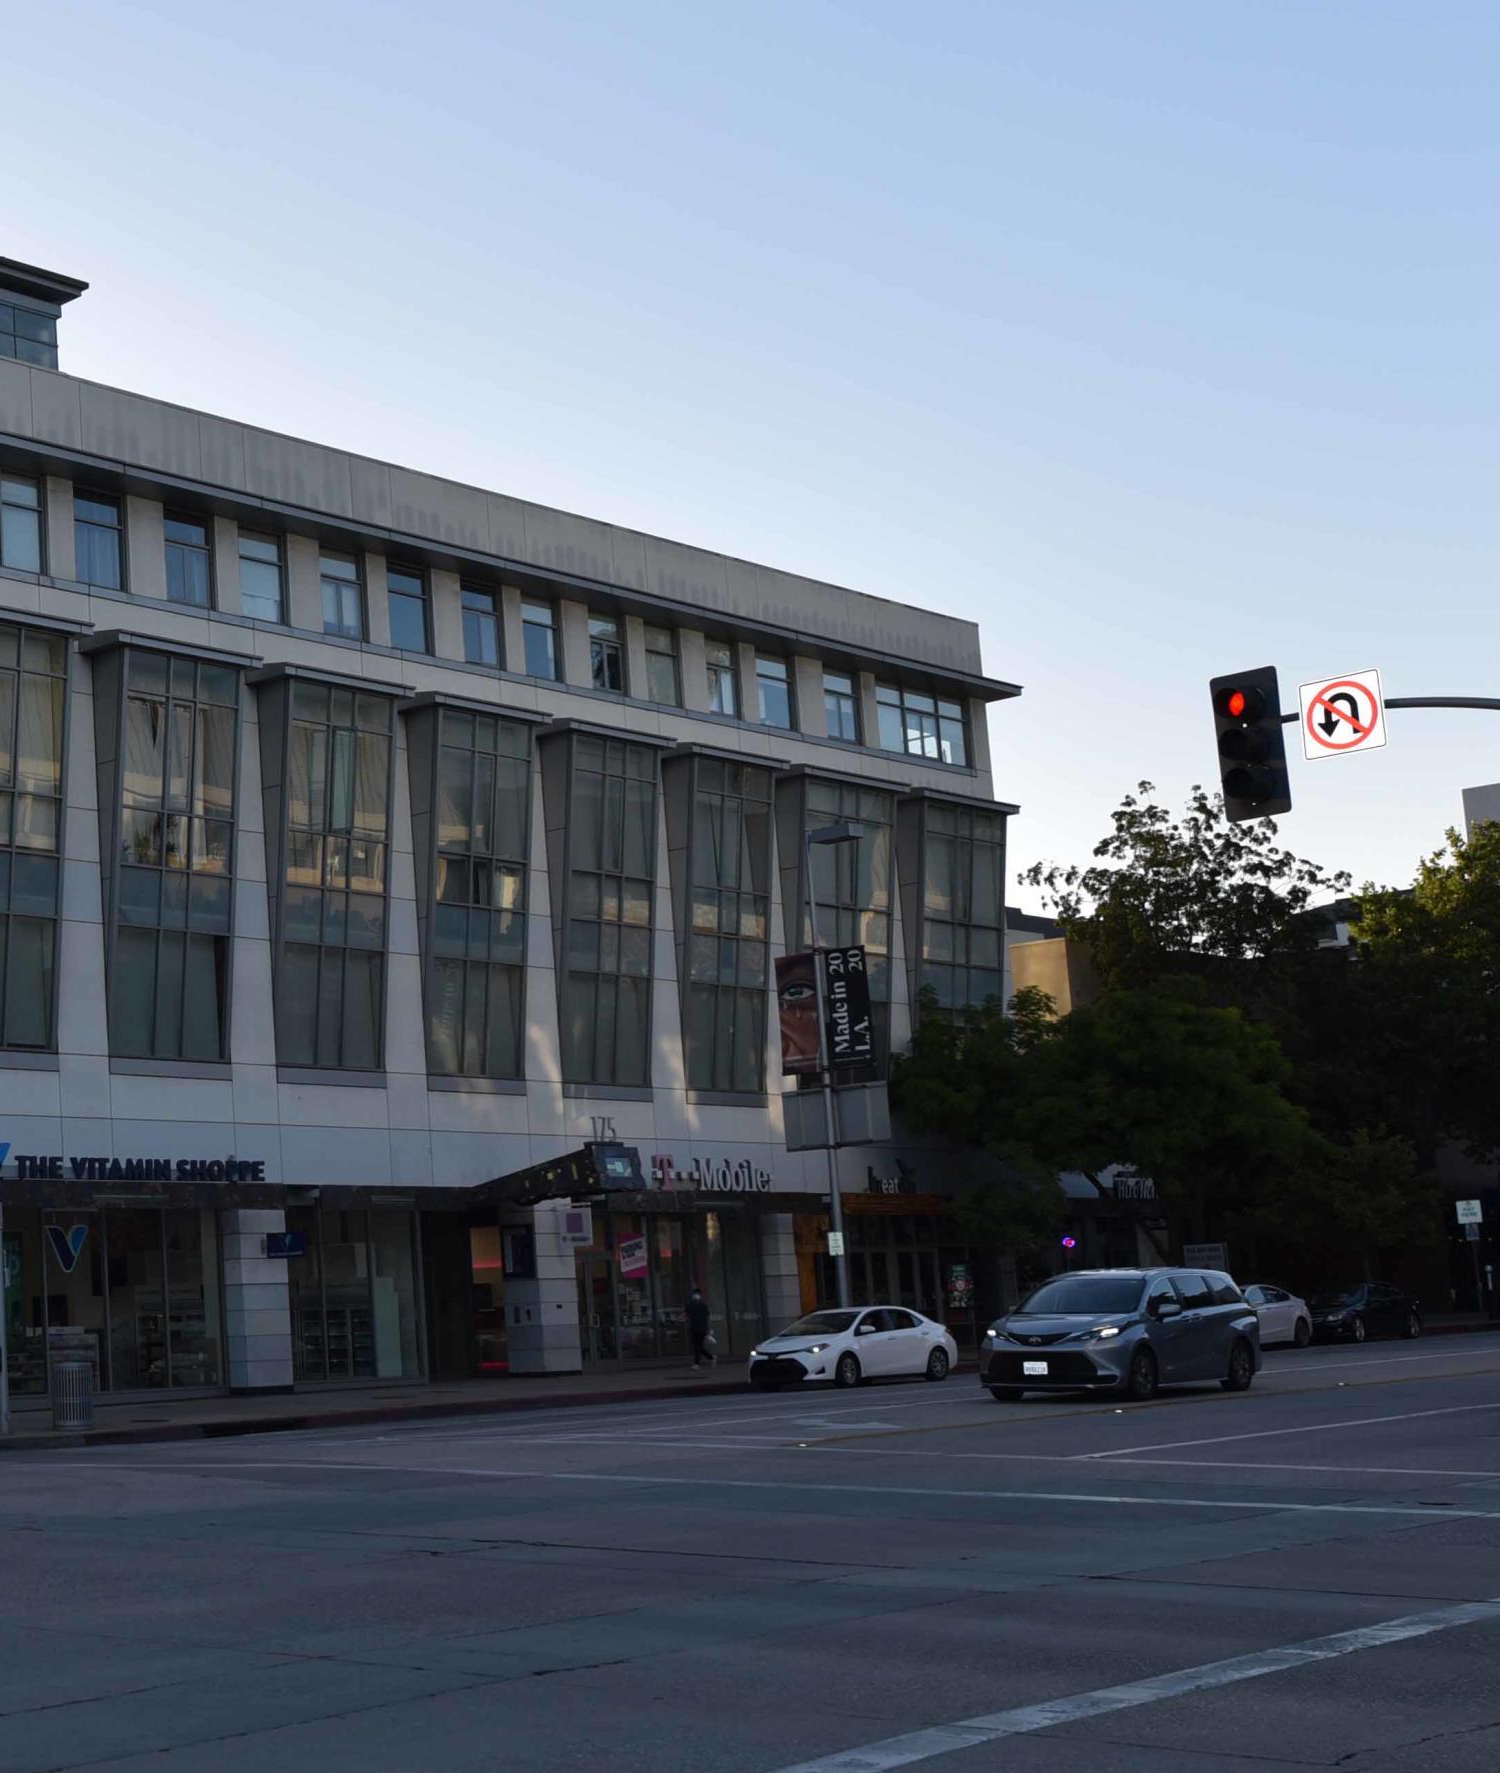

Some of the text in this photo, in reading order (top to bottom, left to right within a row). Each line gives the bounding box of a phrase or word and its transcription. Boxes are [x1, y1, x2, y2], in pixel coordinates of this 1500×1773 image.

[828, 952, 851, 1053] Made in 20
[847, 949, 871, 1051] L.A. 20
[590, 1116, 617, 1142] 175
[14, 1155, 266, 1182] THE VITAMIN SHOPPE
